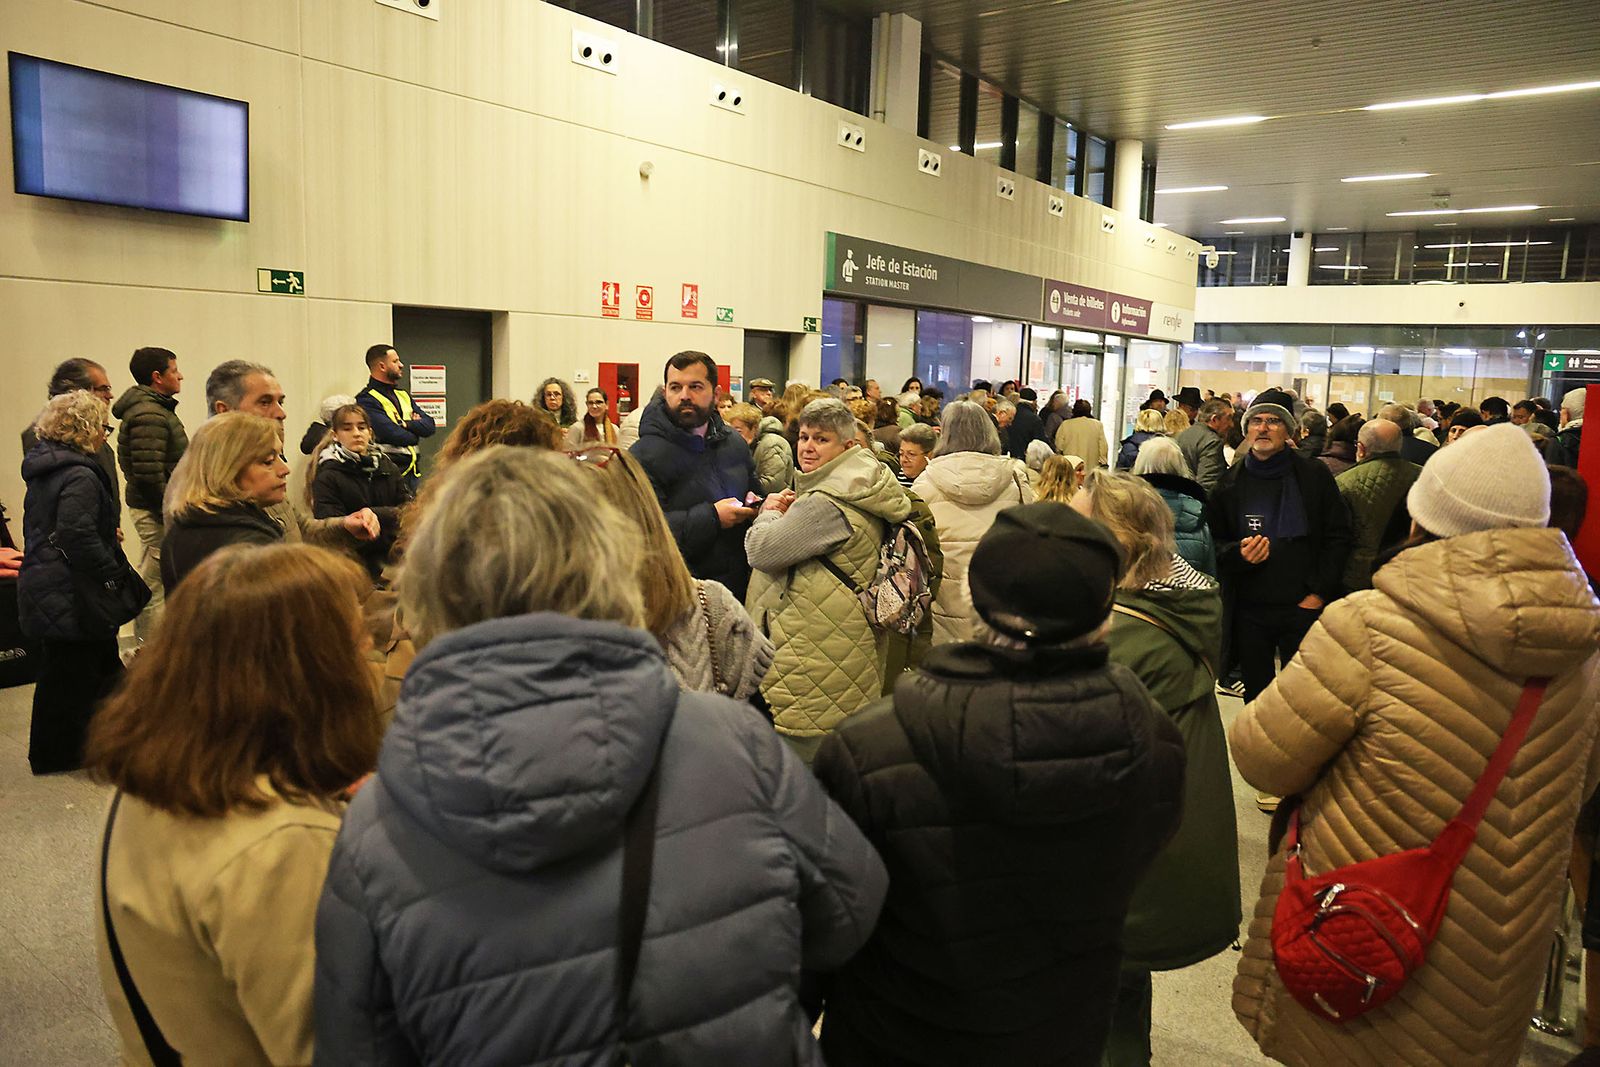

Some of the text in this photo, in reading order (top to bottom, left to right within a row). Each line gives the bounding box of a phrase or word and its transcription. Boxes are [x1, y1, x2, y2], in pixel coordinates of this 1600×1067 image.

[866, 254, 938, 280] Jefe de Estación
[865, 275, 910, 291] STATION MASTER
[1064, 292, 1104, 310] Venta de billetes
[1163, 312, 1182, 332] renfe
